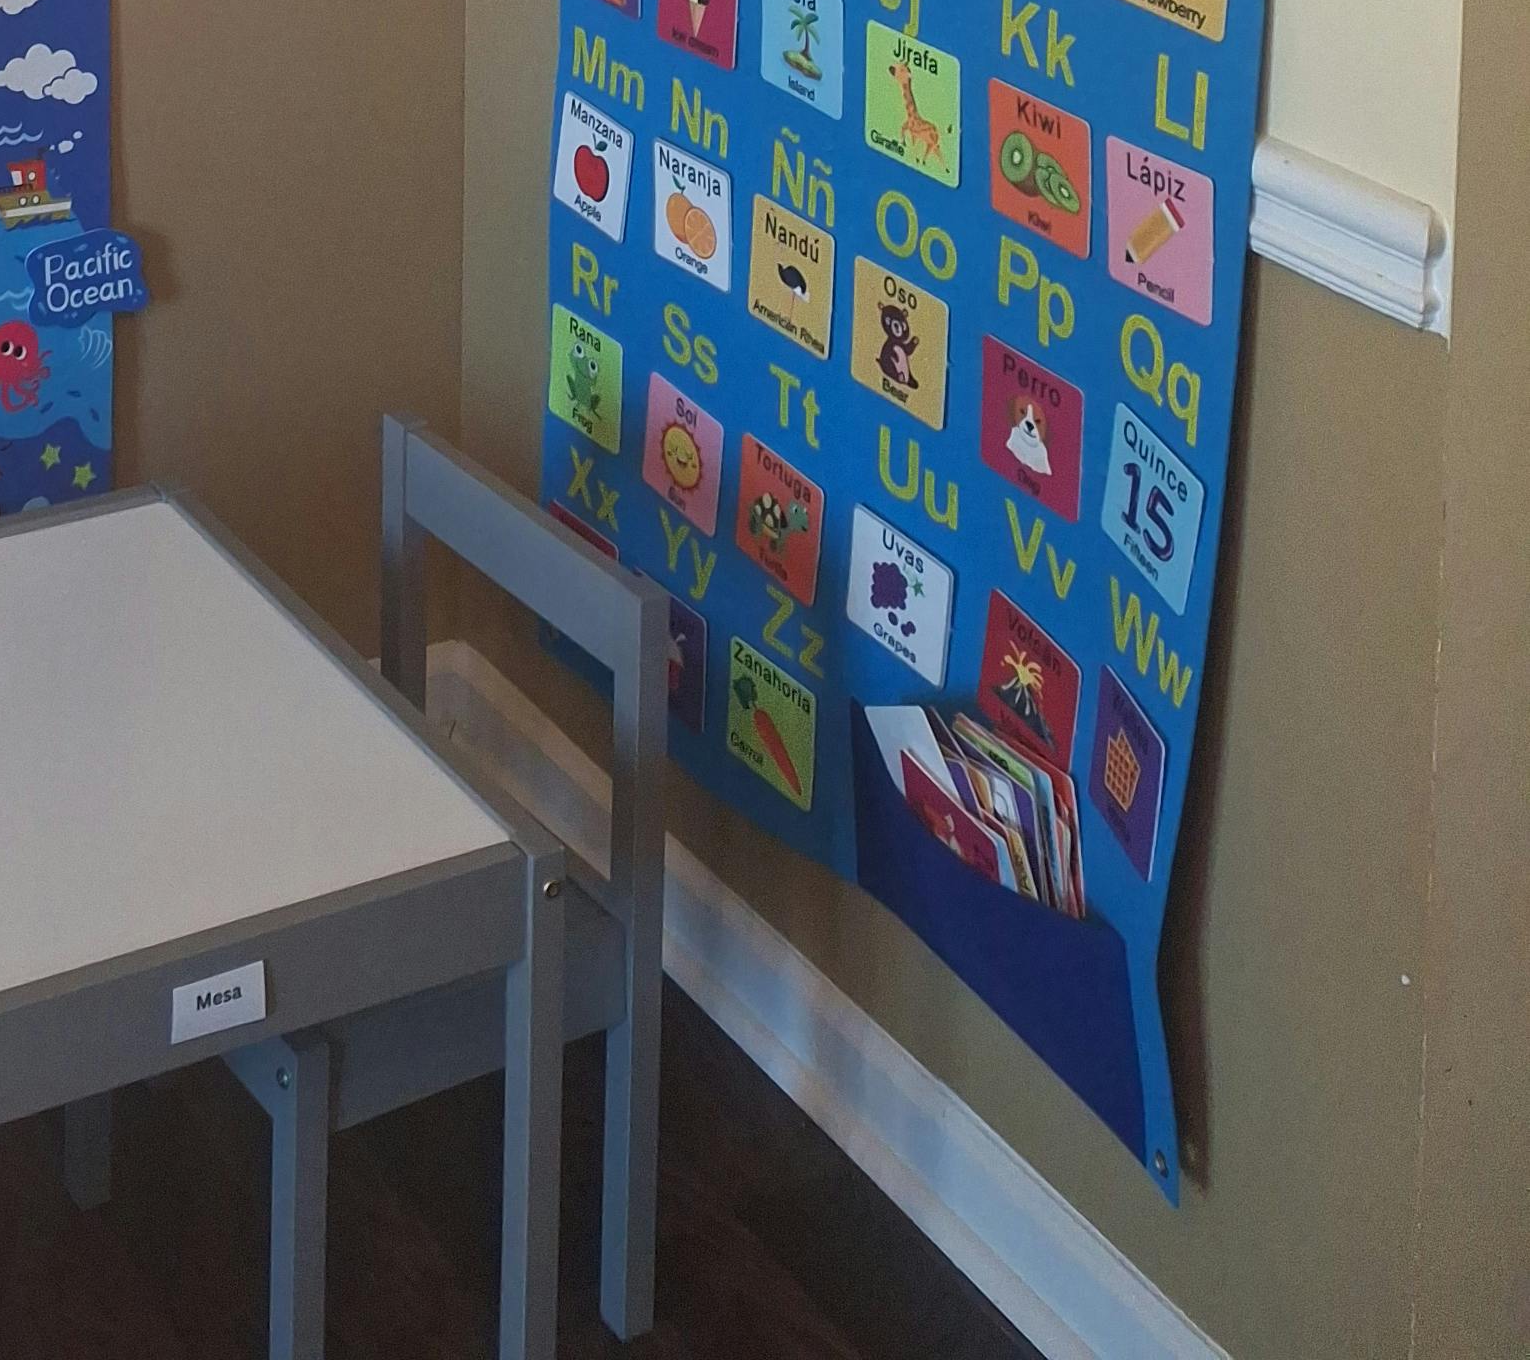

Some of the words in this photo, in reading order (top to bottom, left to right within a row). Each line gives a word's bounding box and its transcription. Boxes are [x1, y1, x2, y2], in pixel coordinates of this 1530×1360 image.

[571, 99, 624, 149] Manzana
[659, 146, 722, 197] Naranja
[1126, 152, 1187, 202] Lápiz
[44, 245, 133, 285] Pacific
[46, 277, 133, 312] Ocean
[1123, 419, 1189, 503] Quince
[882, 527, 926, 575] Uvas
[734, 640, 813, 715] Zanahoria
[196, 983, 243, 1011] Mesa
